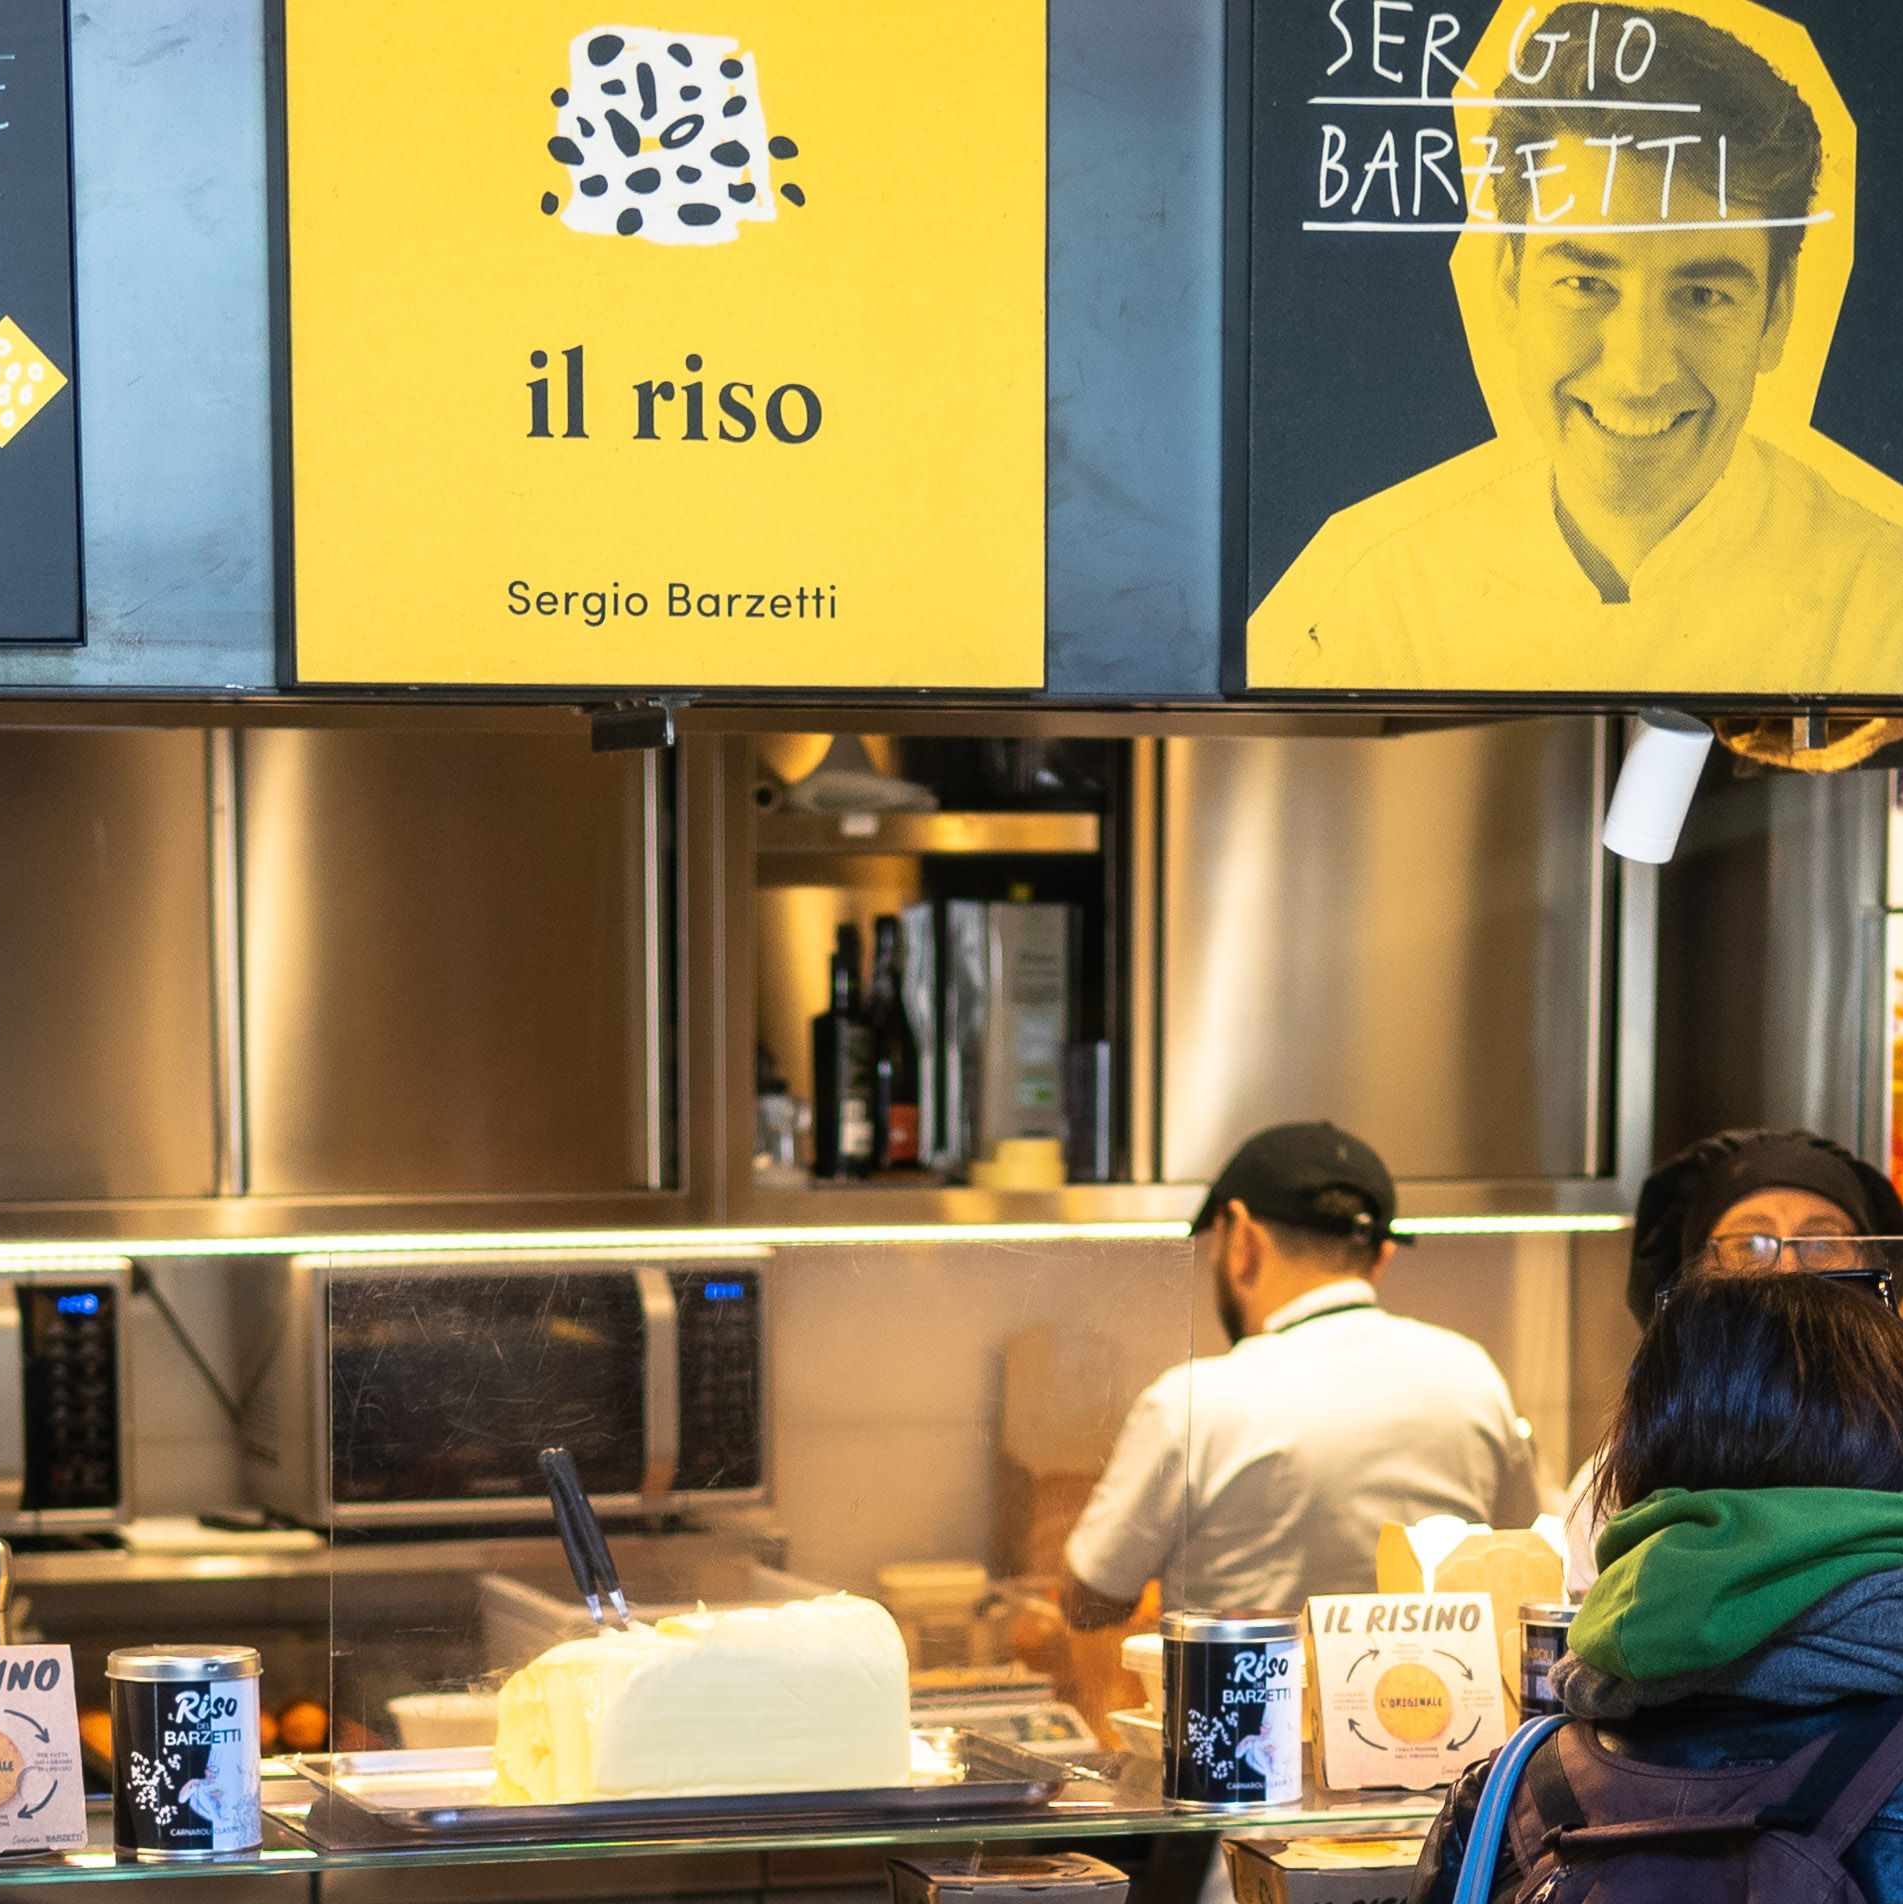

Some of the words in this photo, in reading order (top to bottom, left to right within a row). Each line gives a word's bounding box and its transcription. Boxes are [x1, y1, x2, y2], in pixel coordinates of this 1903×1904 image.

[1326, 0, 1659, 99] SERGIO
[1317, 123, 1729, 224] BARZETTI
[525, 345, 590, 440] il
[632, 353, 824, 445] riso
[506, 579, 649, 628] Sergio
[668, 582, 838, 620] Barzetti
[1324, 1605, 1352, 1633] IL
[1366, 1603, 1481, 1633] RISINO
[1234, 1650, 1289, 1684] Riso
[175, 1690, 238, 1724] Riso
[164, 1729, 242, 1746] BARZETTI
